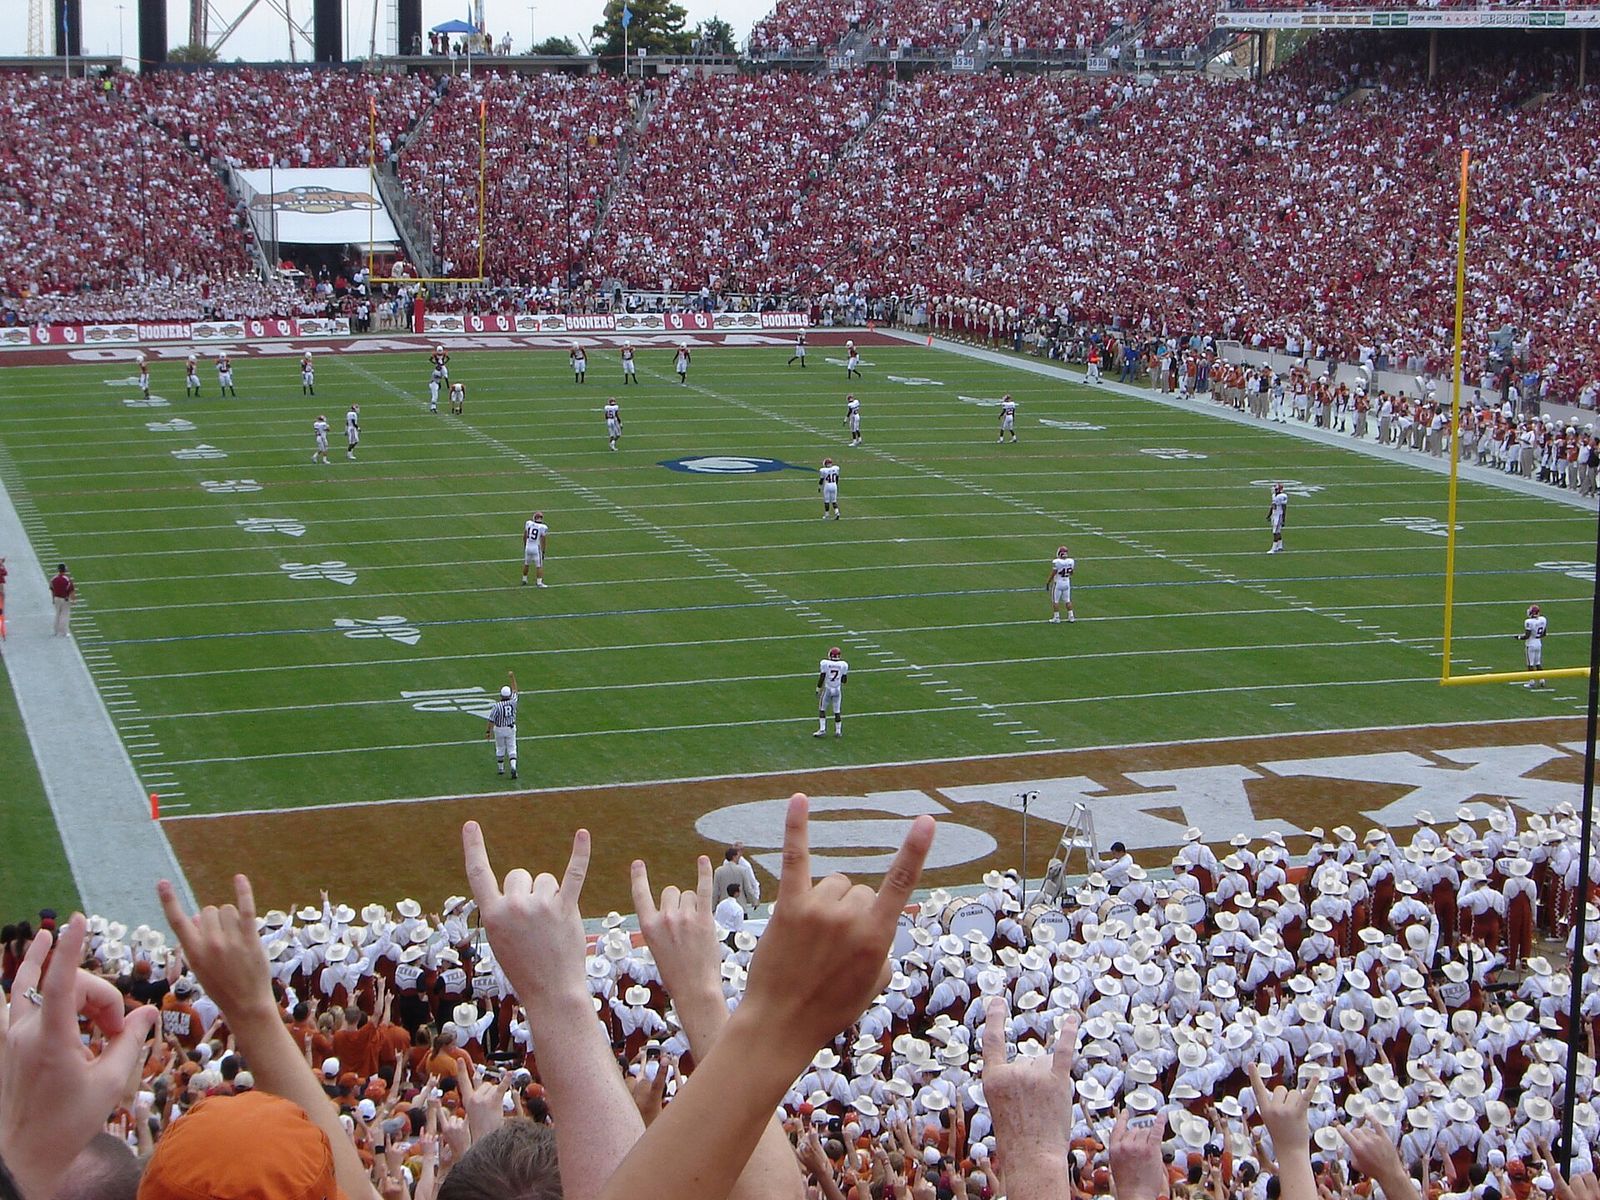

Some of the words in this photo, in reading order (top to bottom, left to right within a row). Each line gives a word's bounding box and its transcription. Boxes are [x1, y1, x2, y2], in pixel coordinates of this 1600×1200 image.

[567, 316, 615, 330] SOONERS
[762, 313, 809, 328] SOONERS
[139, 324, 191, 339] SOONERS
[825, 473, 838, 484] 40
[527, 527, 539, 541] 19
[830, 669, 839, 682] 7
[504, 705, 514, 717] R
